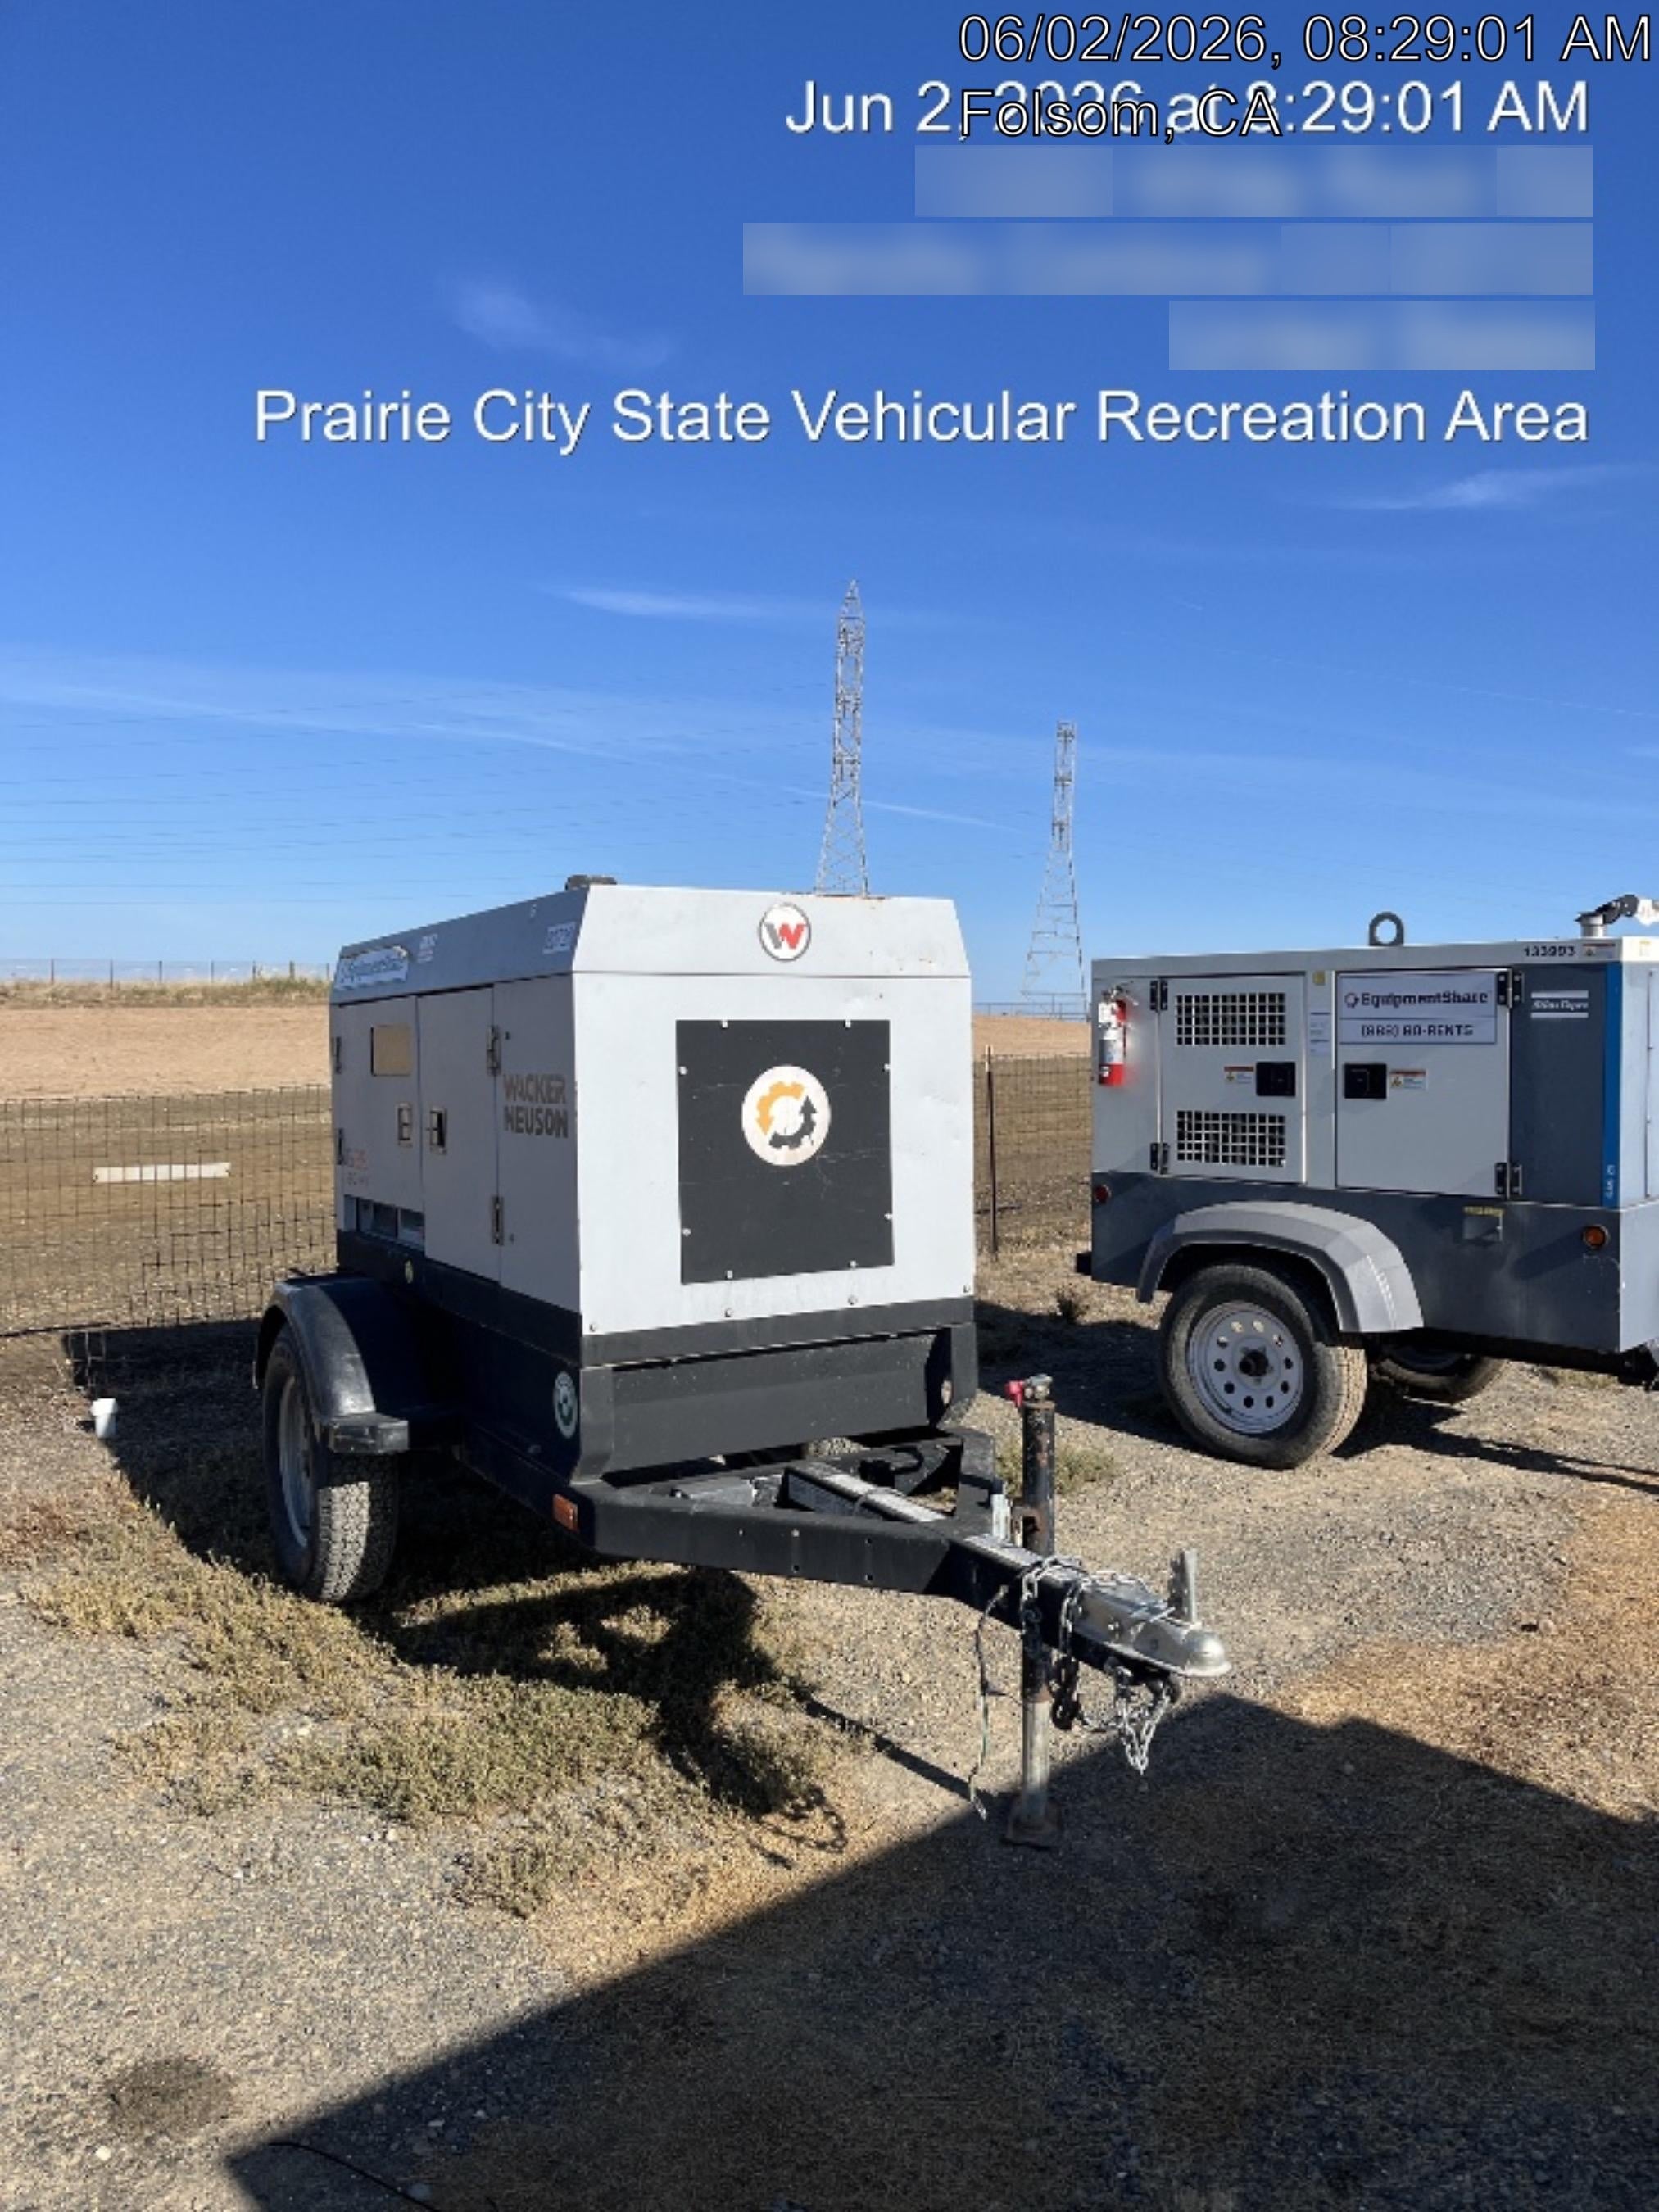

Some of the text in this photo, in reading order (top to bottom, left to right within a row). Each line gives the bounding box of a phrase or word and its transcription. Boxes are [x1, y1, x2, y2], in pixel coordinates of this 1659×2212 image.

[1361, 990, 1488, 1008] EquipmentShare
[503, 1073, 566, 1104] WACKER
[503, 1105, 569, 1138] NEUSON
